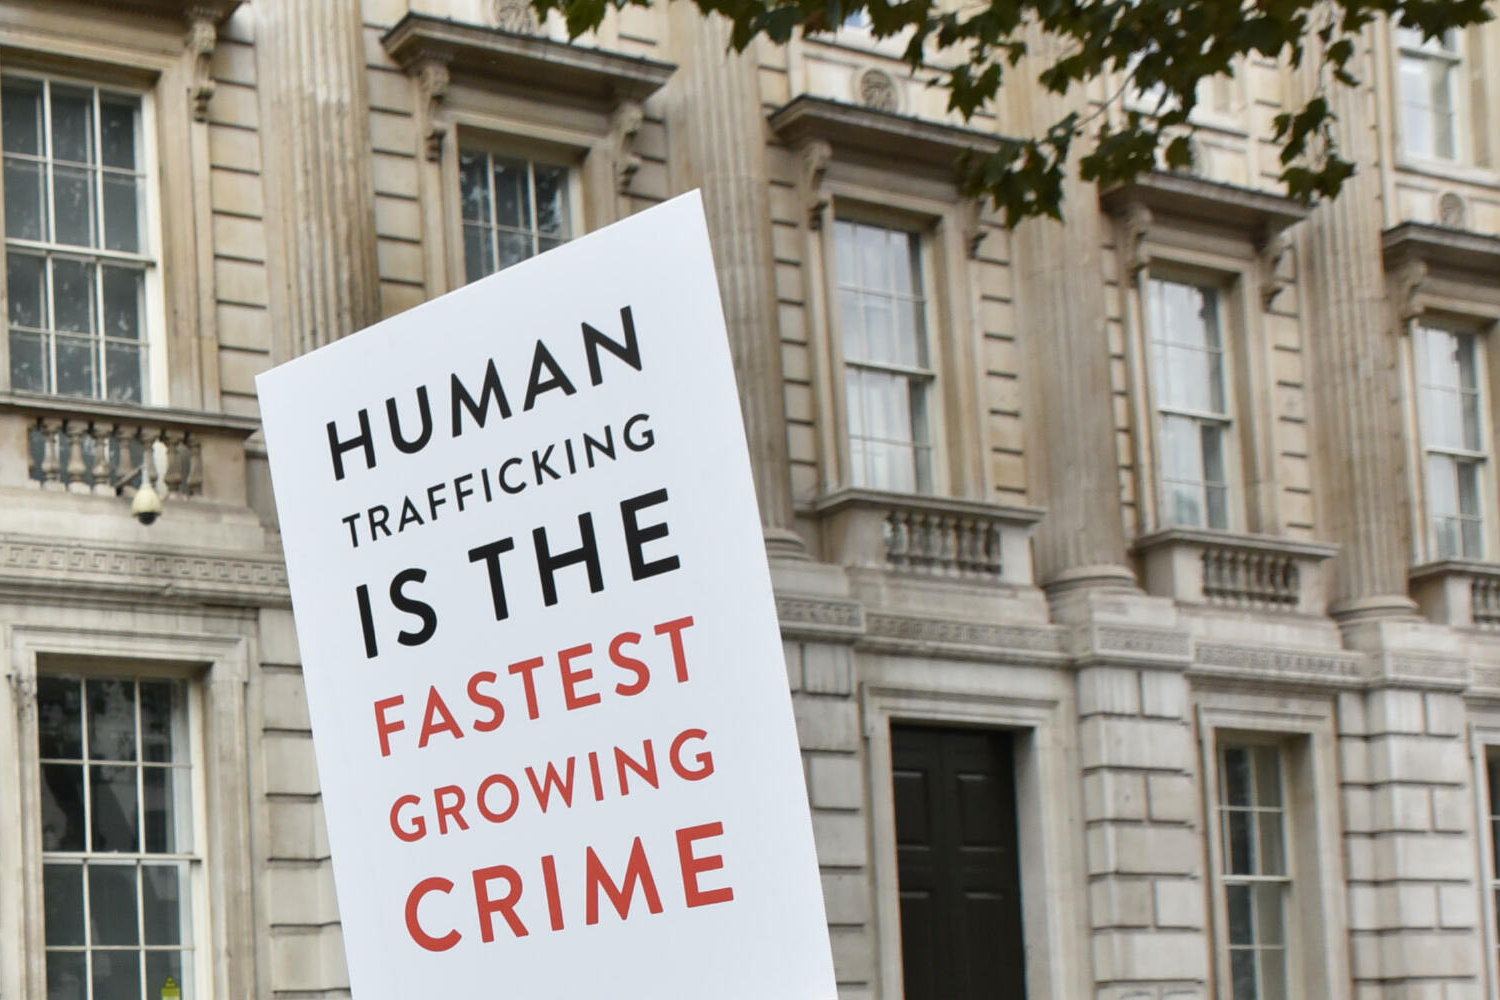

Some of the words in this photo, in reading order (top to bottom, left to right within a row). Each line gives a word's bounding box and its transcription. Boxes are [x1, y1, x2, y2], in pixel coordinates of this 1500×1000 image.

[326, 305, 642, 481] HUMAN
[342, 413, 655, 548] TRAFFICKING
[356, 568, 438, 659] IS
[467, 488, 681, 621] THE
[374, 616, 694, 756] FASTEST
[390, 728, 714, 842] GROWING
[405, 821, 734, 952] CRIME
